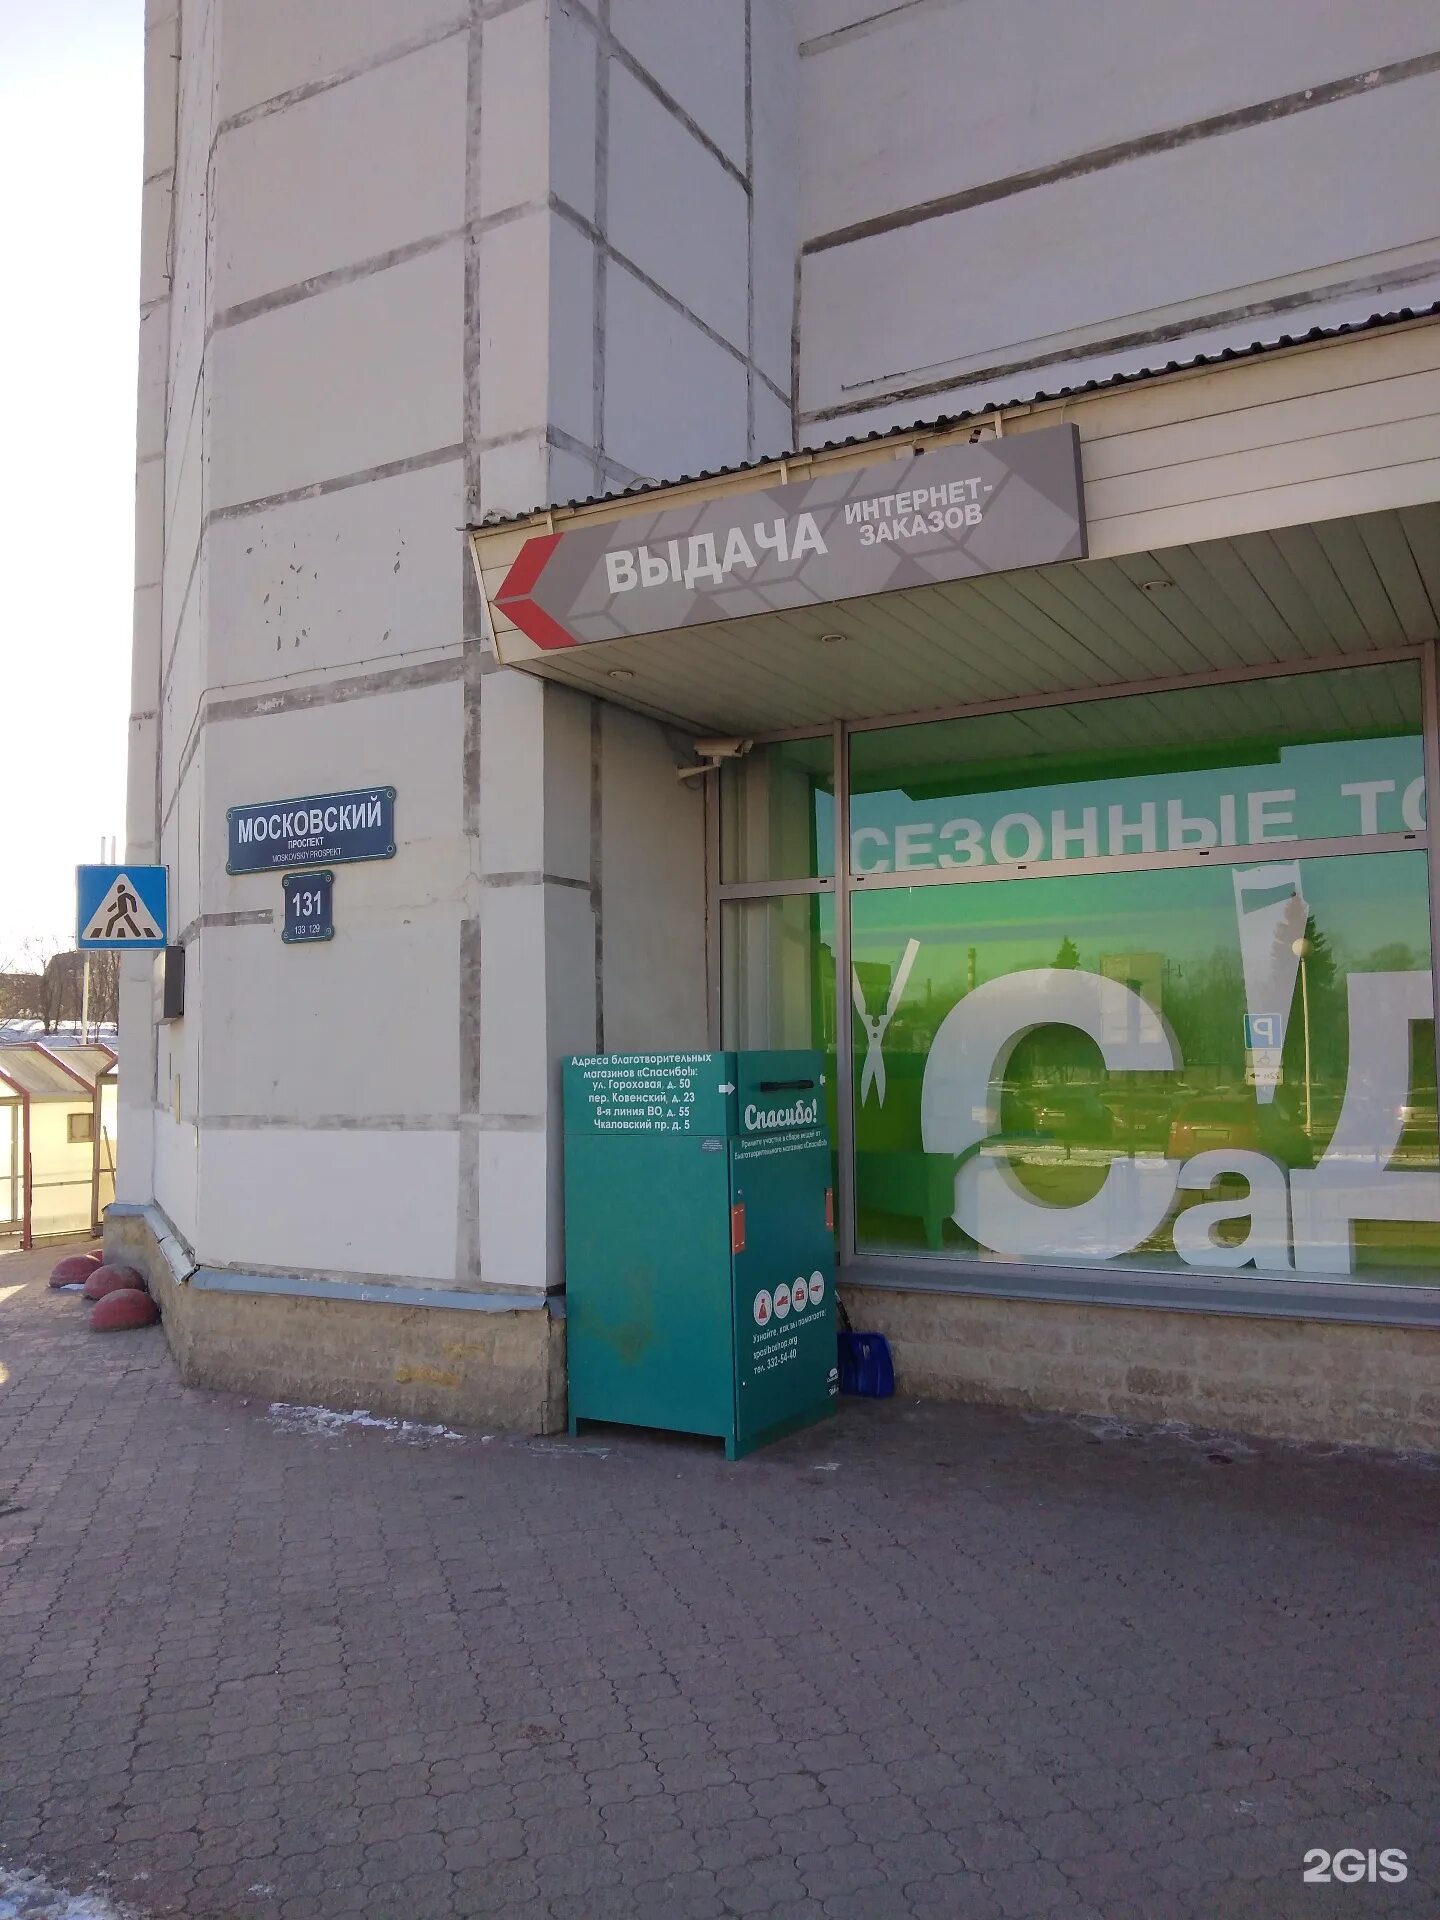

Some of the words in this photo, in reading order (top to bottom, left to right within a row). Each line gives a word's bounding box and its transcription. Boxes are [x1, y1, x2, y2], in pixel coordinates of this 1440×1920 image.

[844, 477, 993, 525] ИНТЕРНЕТ-
[859, 503, 983, 546] ЗАКАЗОВ
[605, 512, 829, 594] ВЫДАЧА
[238, 795, 382, 844] МОСКОВСКИЙ
[850, 788, 1299, 874] СЕЗОННЫЕ
[287, 837, 325, 849] ПРОСПЕКТ
[310, 848, 342, 858] PROSPEKT
[292, 890, 321, 917] 131
[294, 925, 306, 935] 133
[309, 924, 321, 934] 129
[571, 1056, 609, 1068] Адреса
[611, 1054, 712, 1066] благотворительных
[583, 1069, 635, 1079] магазинов
[637, 1066, 698, 1077] «Спасибо!»:
[592, 1081, 606, 1091] ул.
[608, 1079, 665, 1091] Гороховая,
[667, 1081, 677, 1090] д.
[679, 1078, 691, 1089] 50
[588, 1094, 609, 1105] пер.
[612, 1091, 668, 1104] Ковенский,
[671, 1094, 681, 1103] д.
[683, 1091, 695, 1102] 23
[596, 1106, 611, 1116] 8-я
[613, 1108, 645, 1116] линия
[647, 1105, 663, 1118] ВО,
[666, 1109, 676, 1117] д.
[678, 1106, 690, 1117] 55
[744, 1098, 817, 1130] Спасибо!
[594, 1119, 652, 1129] Чкаловский
[654, 1121, 670, 1131] пр.
[671, 1121, 682, 1131] д.
[684, 1119, 690, 1130] 5
[753, 1365, 766, 1375] тел.
[766, 1348, 797, 1370] 332-54-40
